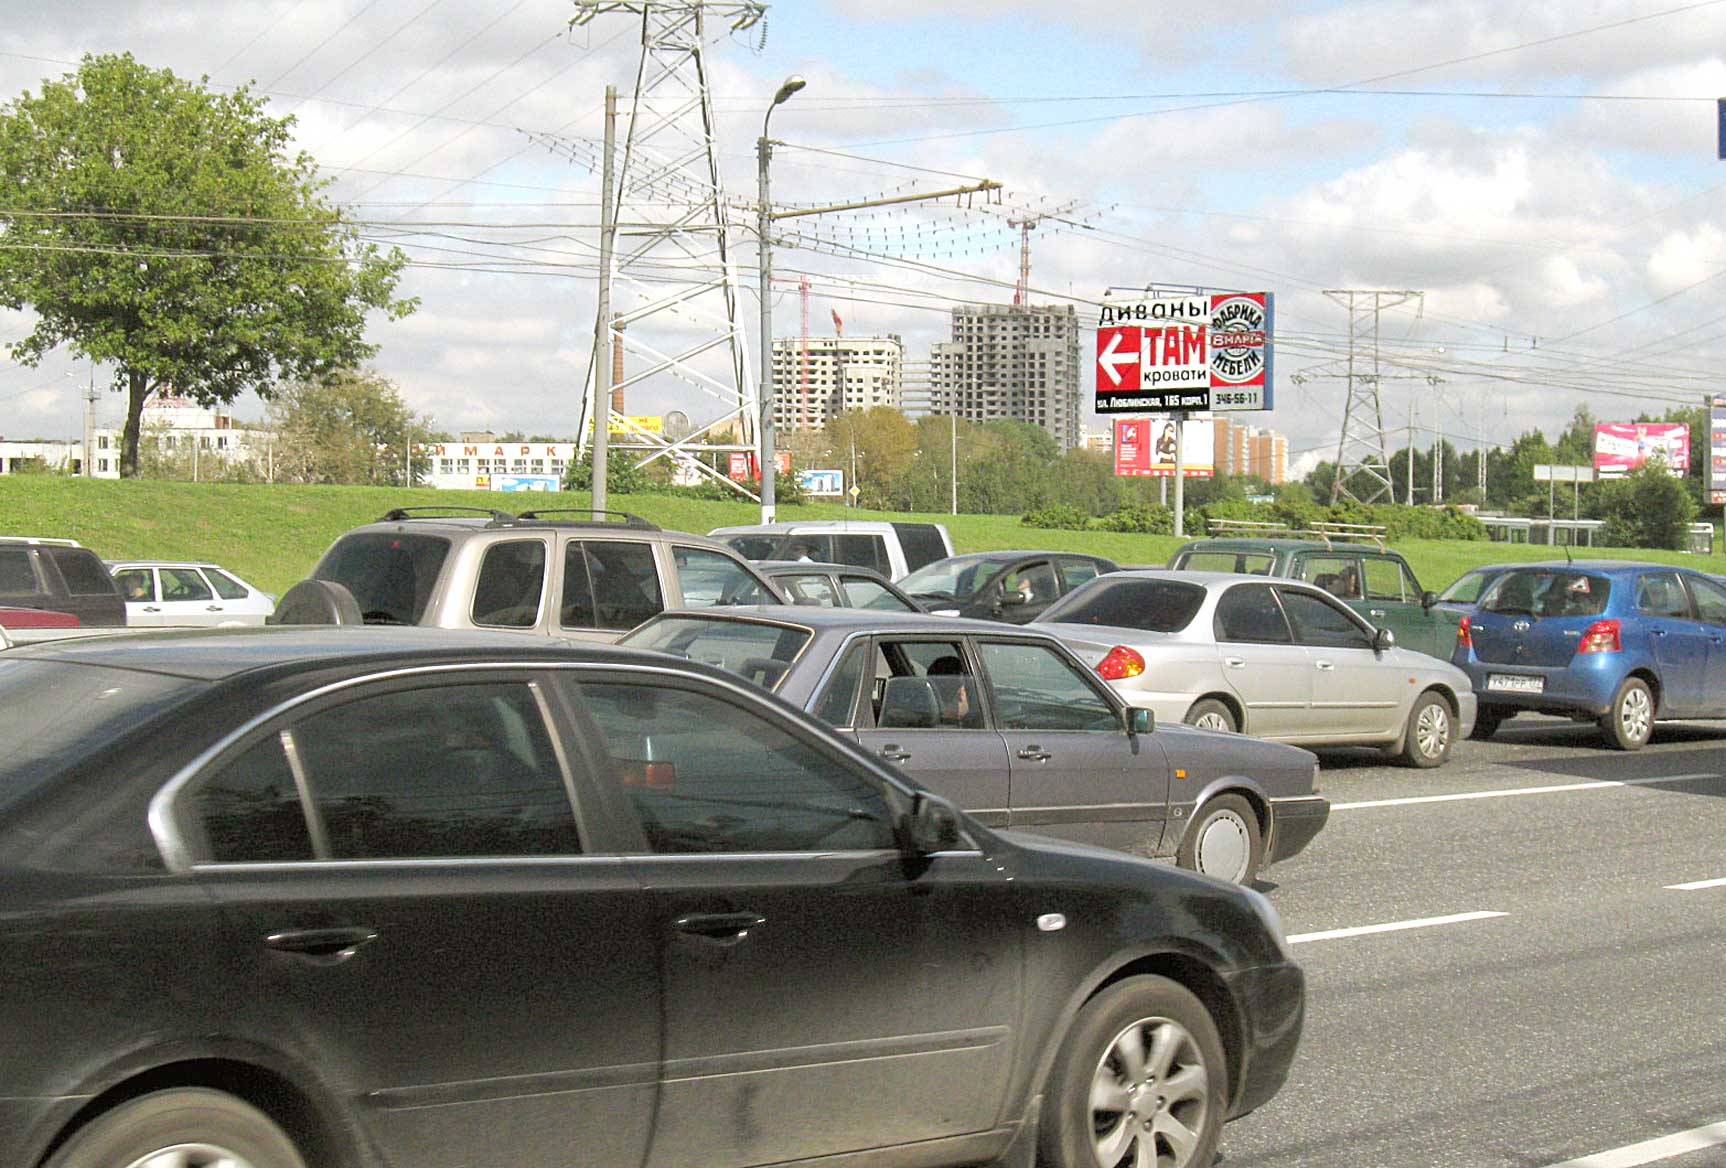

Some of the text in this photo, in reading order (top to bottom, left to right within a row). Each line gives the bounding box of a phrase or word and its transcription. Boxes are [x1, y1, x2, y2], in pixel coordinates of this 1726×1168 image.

[1213, 303, 1262, 329] ФАБРИКА
[1144, 325, 1206, 366] ТАМ
[1213, 349, 1261, 375] МЕБЕЛИ
[1144, 369, 1206, 386] кровати
